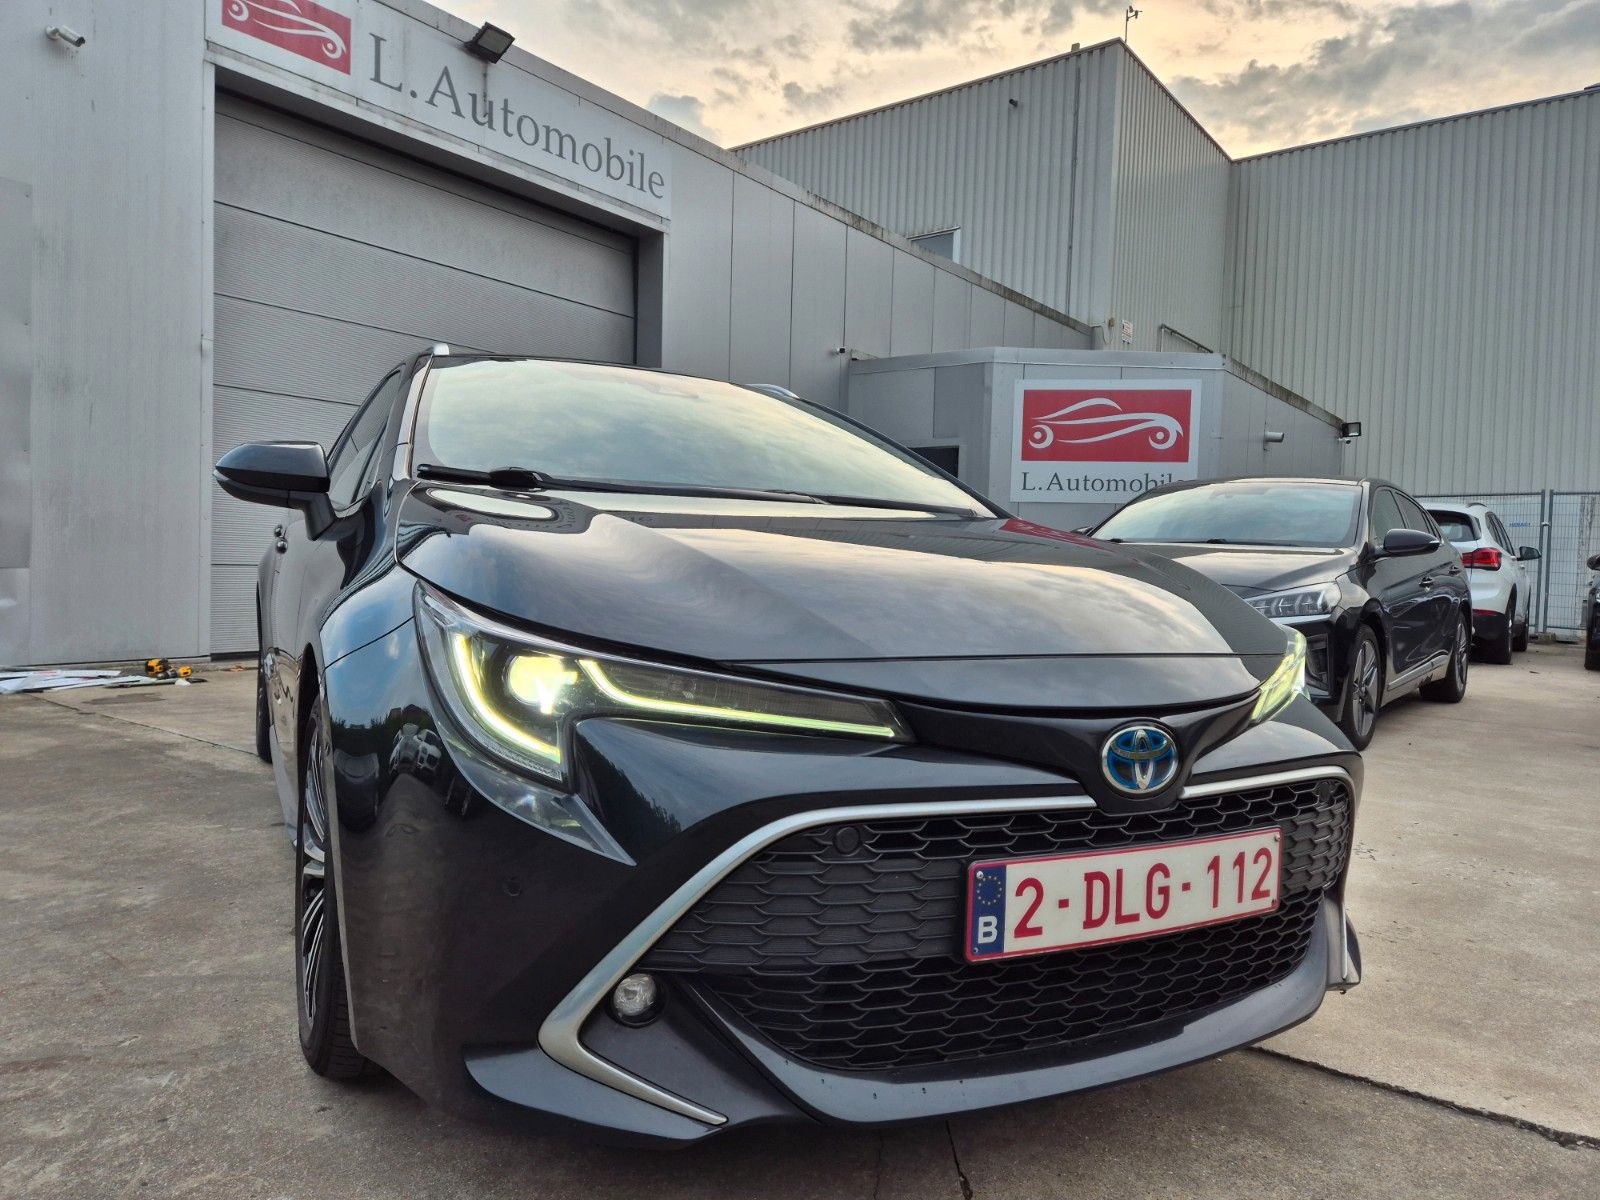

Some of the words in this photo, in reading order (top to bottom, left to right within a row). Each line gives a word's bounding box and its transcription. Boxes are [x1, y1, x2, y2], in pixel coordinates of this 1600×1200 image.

[369, 32, 665, 199] L.Automobile
[1021, 471, 1184, 492] L.Automobil
[977, 915, 998, 944] B
